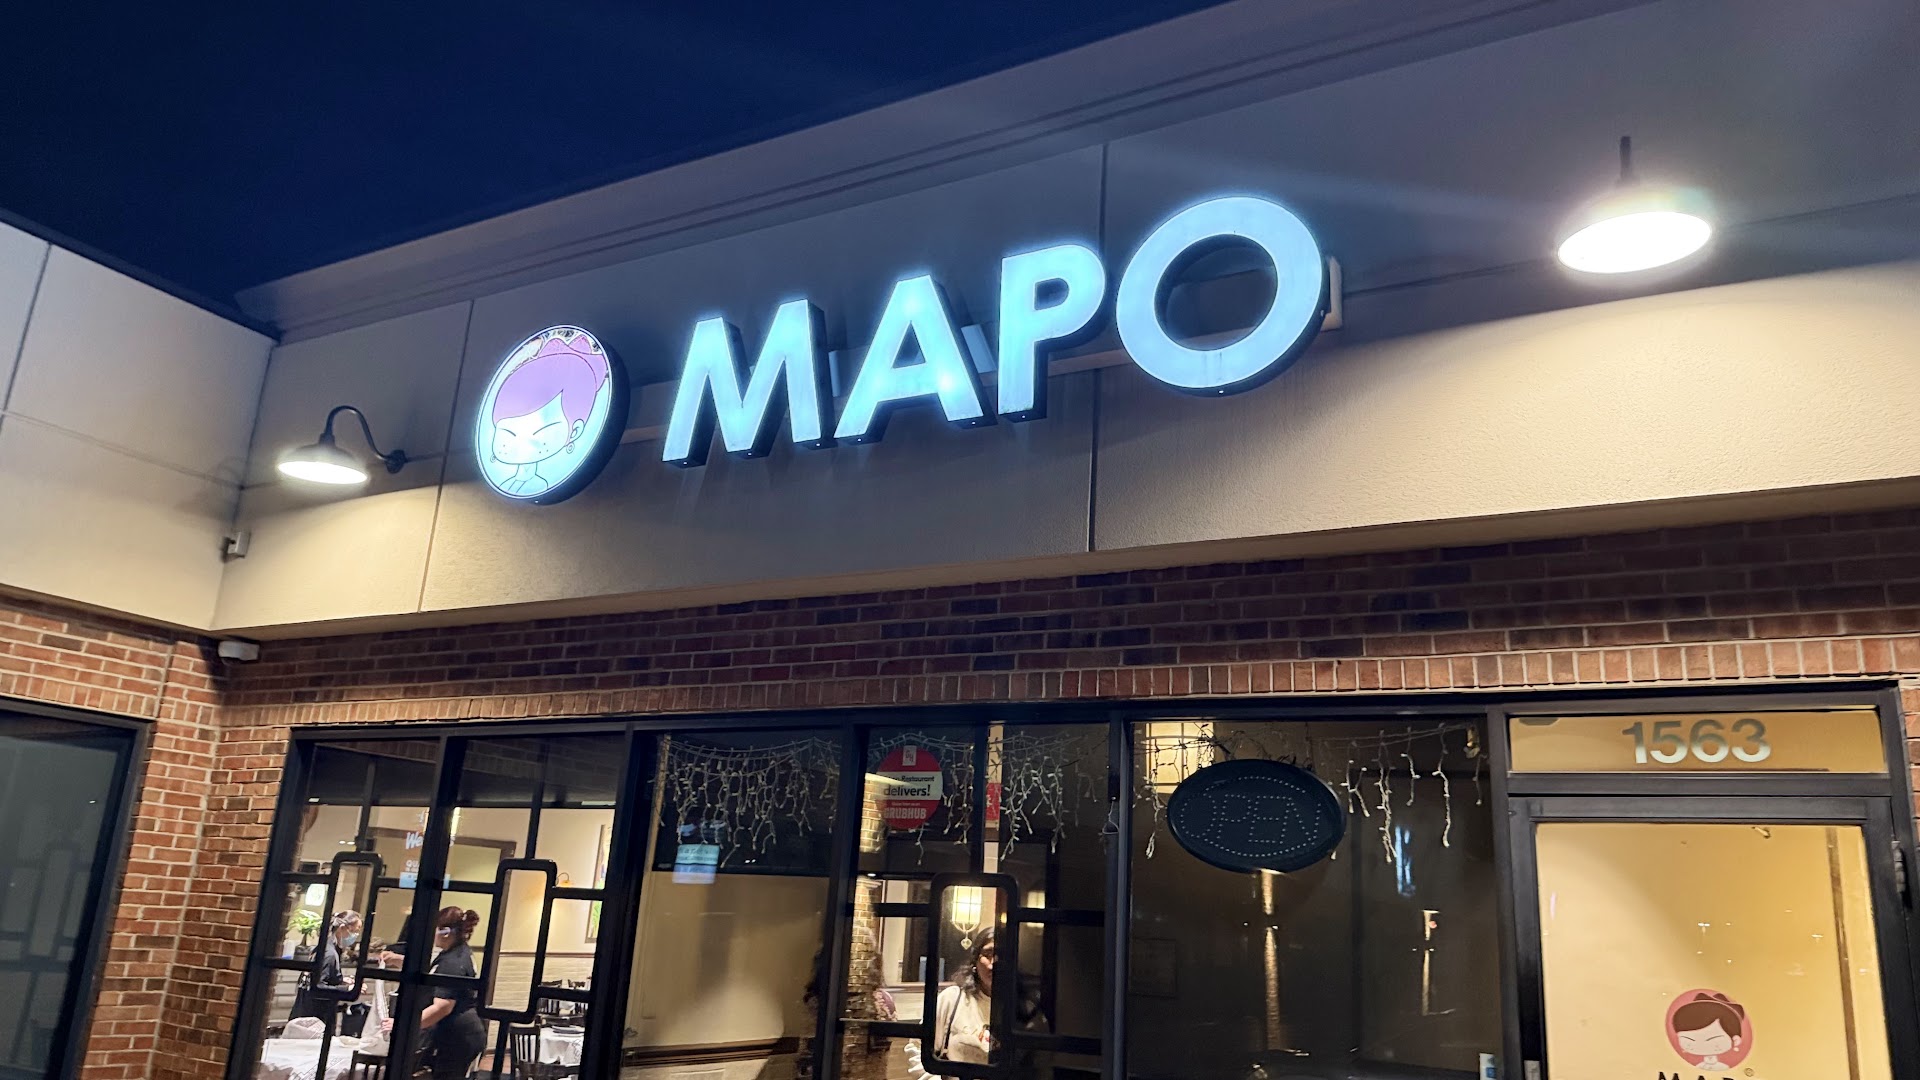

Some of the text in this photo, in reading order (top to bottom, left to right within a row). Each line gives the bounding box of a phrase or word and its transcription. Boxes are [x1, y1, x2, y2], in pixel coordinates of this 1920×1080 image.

[662, 196, 1325, 466] MAPO
[1621, 718, 1772, 764] 1563
[883, 784, 931, 797] delivers!
[884, 807, 927, 820] GRUBHUB
